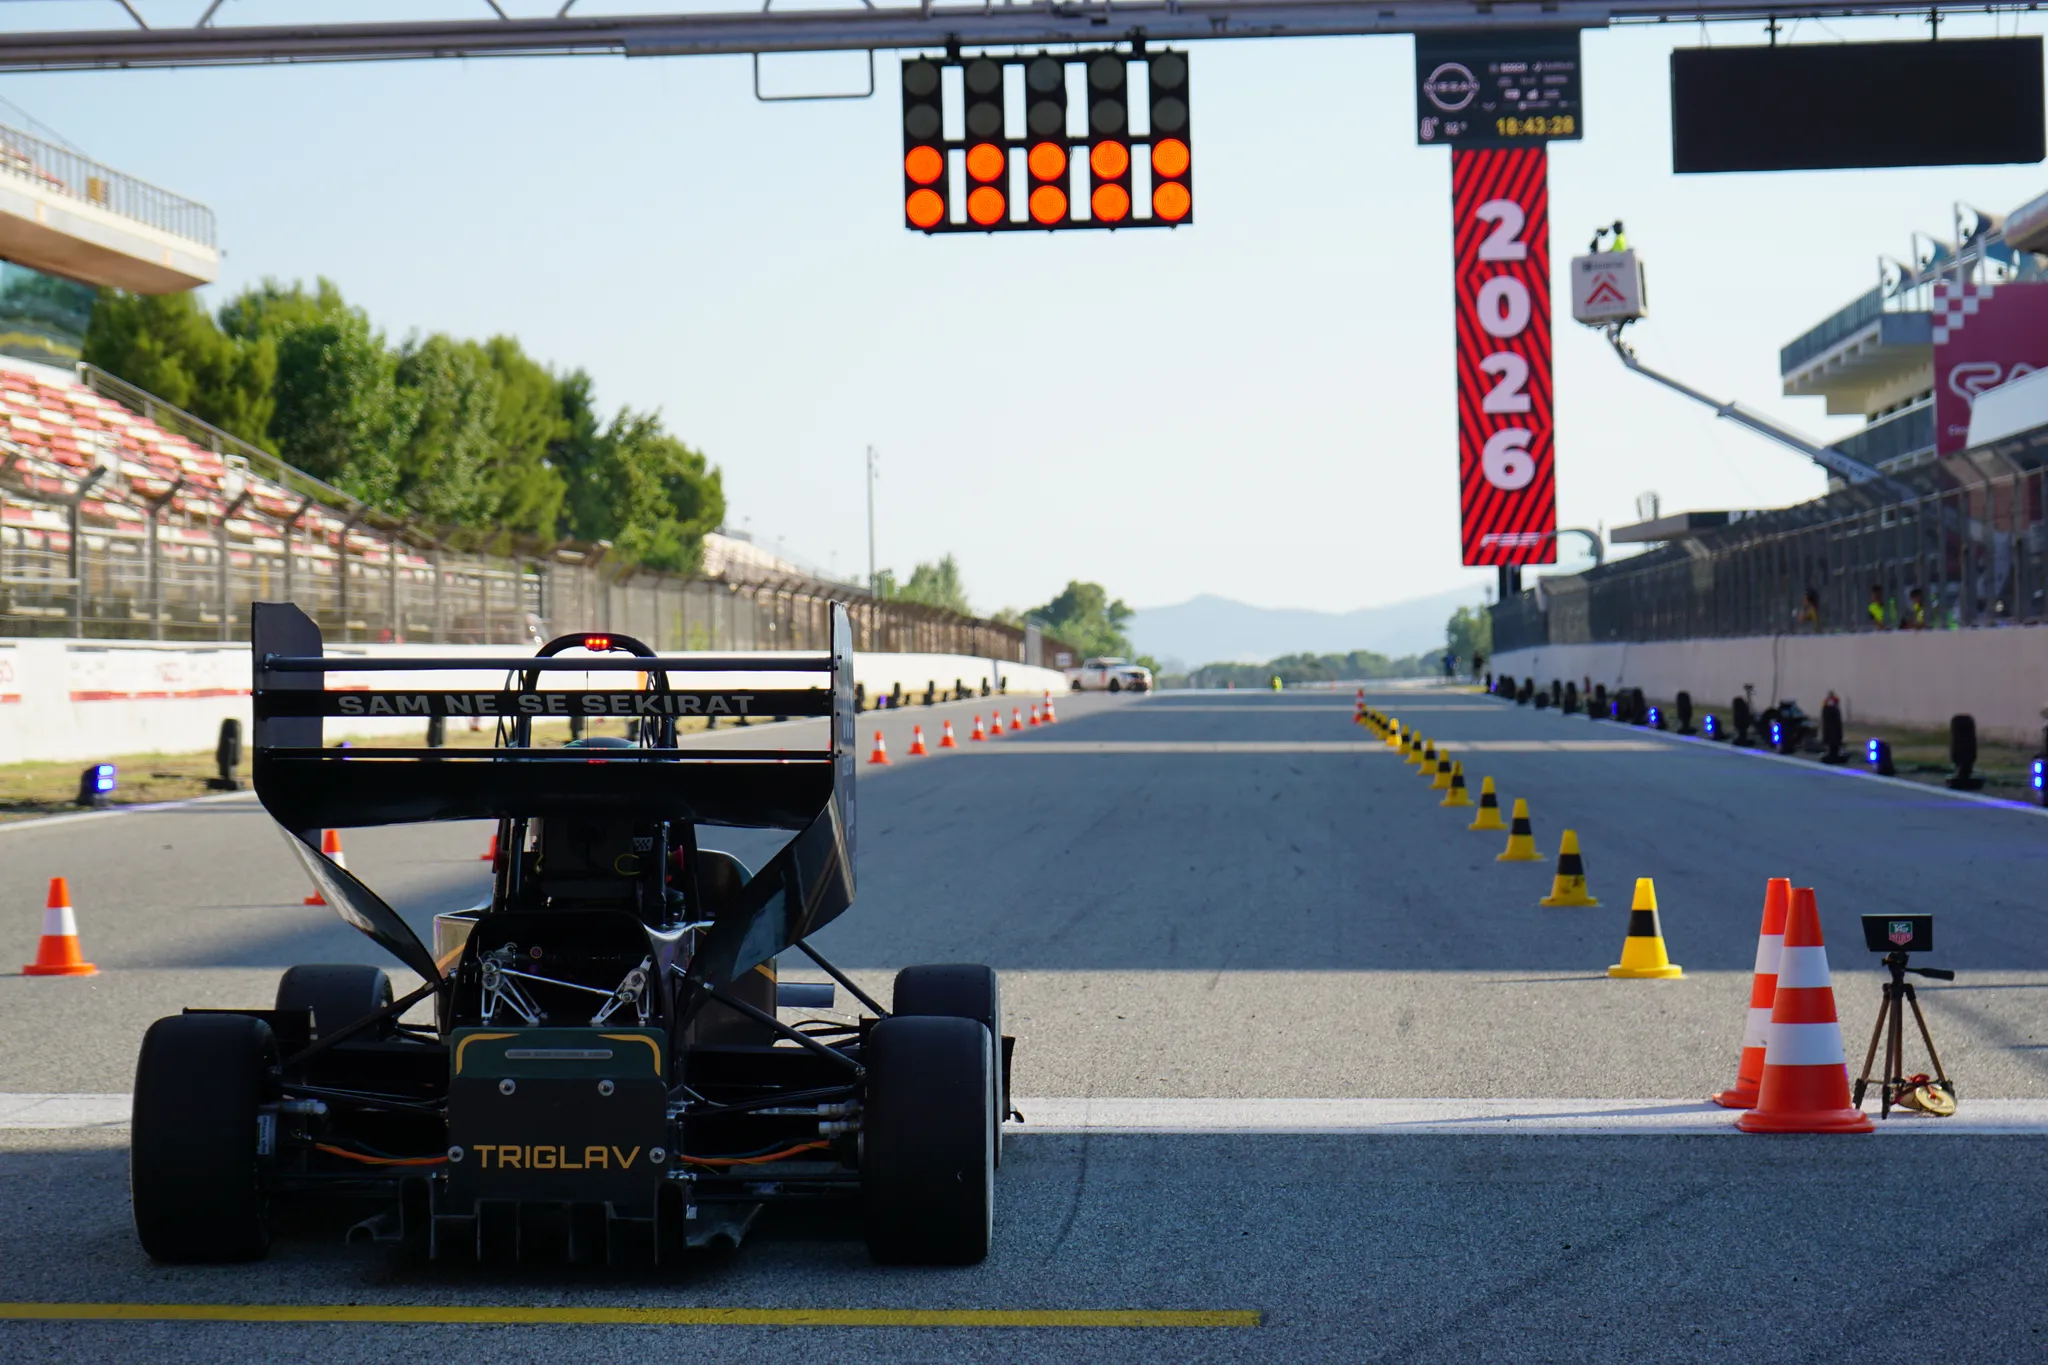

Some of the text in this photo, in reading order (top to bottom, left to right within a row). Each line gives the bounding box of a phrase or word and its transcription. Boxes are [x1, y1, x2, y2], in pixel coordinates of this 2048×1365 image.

[1496, 115, 1575, 136] 18:43:28
[1475, 198, 1536, 490] 2026
[339, 694, 754, 715] SAM NE SE SEKIRAT
[473, 1145, 641, 1169] TRIGLAV
